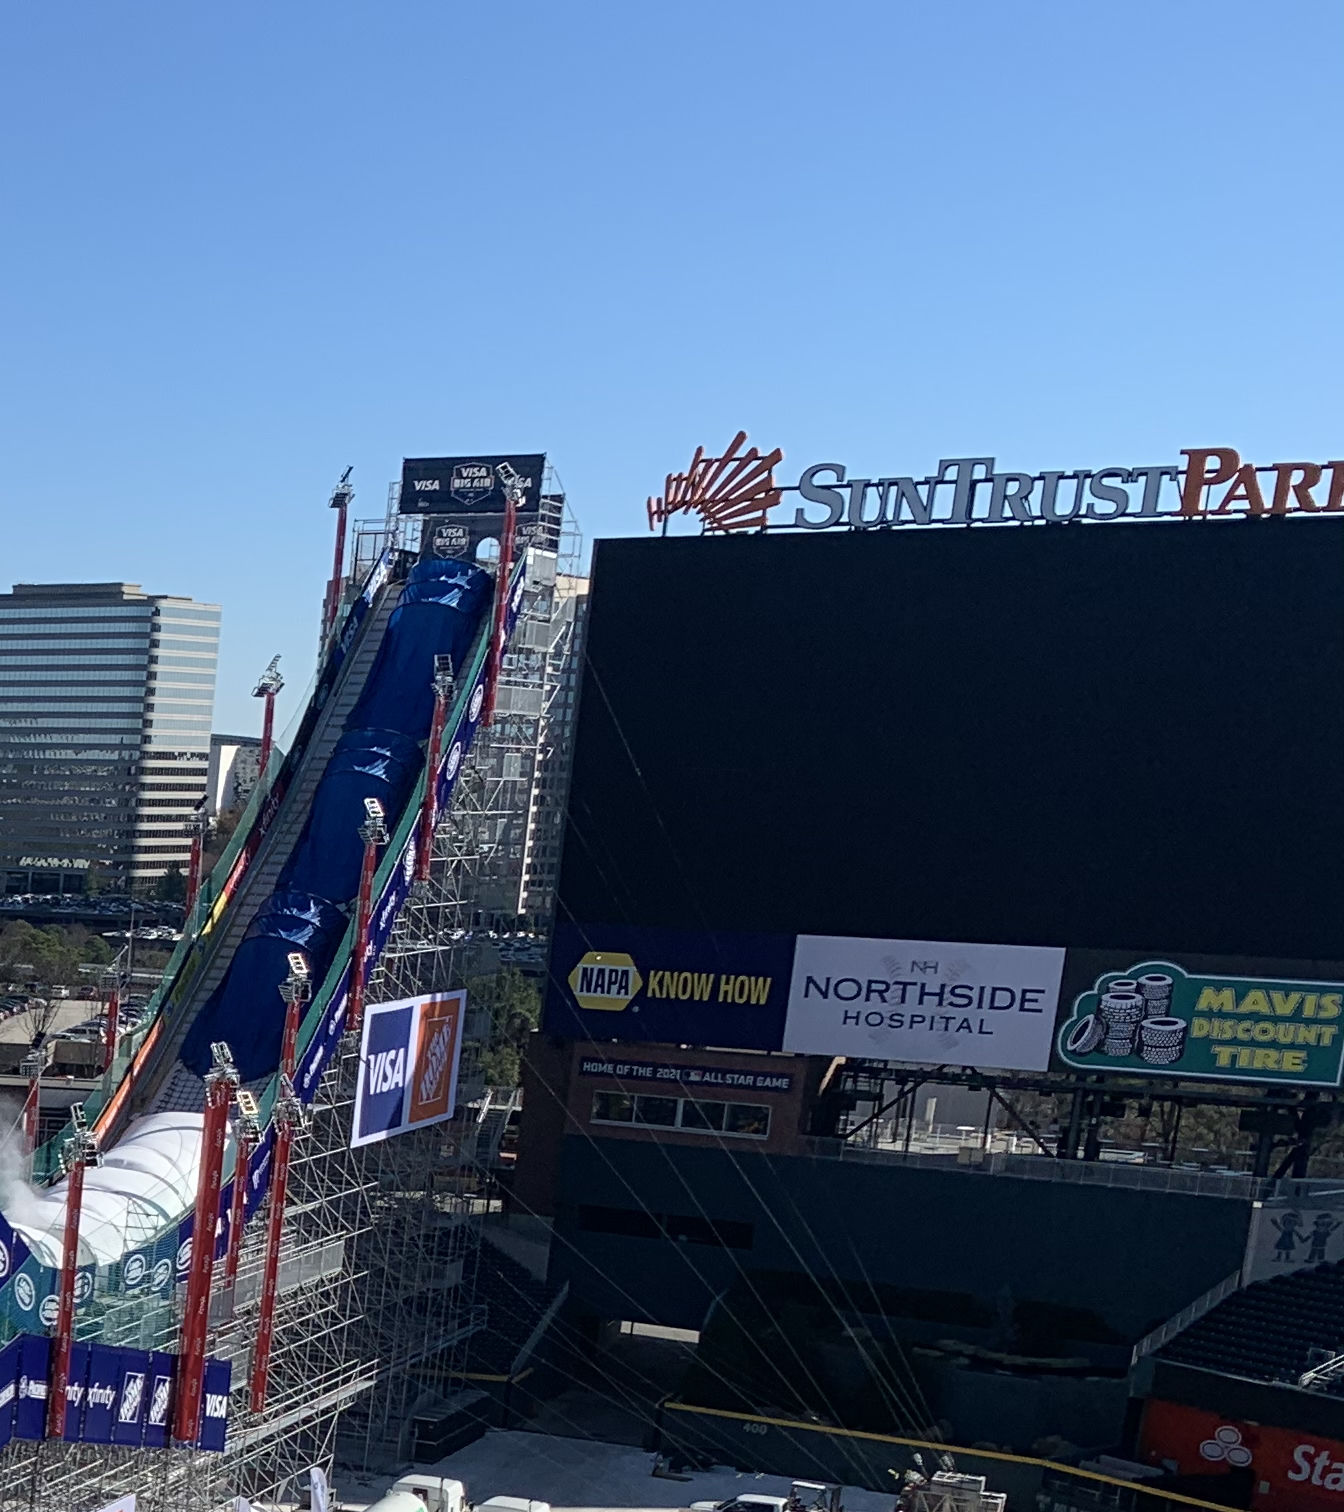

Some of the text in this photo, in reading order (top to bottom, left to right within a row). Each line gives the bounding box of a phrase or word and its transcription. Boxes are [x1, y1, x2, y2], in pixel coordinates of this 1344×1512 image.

[413, 480, 440, 491] VISA
[579, 966, 631, 996] NAPA
[647, 969, 772, 1005] KNOW HOW
[804, 975, 1046, 1013] NORTHSIDE
[1194, 986, 1343, 1019] MAVIS
[841, 1009, 994, 1035] HOSPITAL
[1191, 1017, 1338, 1046] DISCOUNT
[368, 1048, 405, 1095] VISA
[1212, 1045, 1308, 1073] TIRE
[583, 1061, 790, 1089] HOME OF THE 2021 ALL STAR GAME
[87, 1383, 116, 1410] xfinity
[205, 1393, 227, 1419] VISA
[742, 1422, 768, 1436] 400
